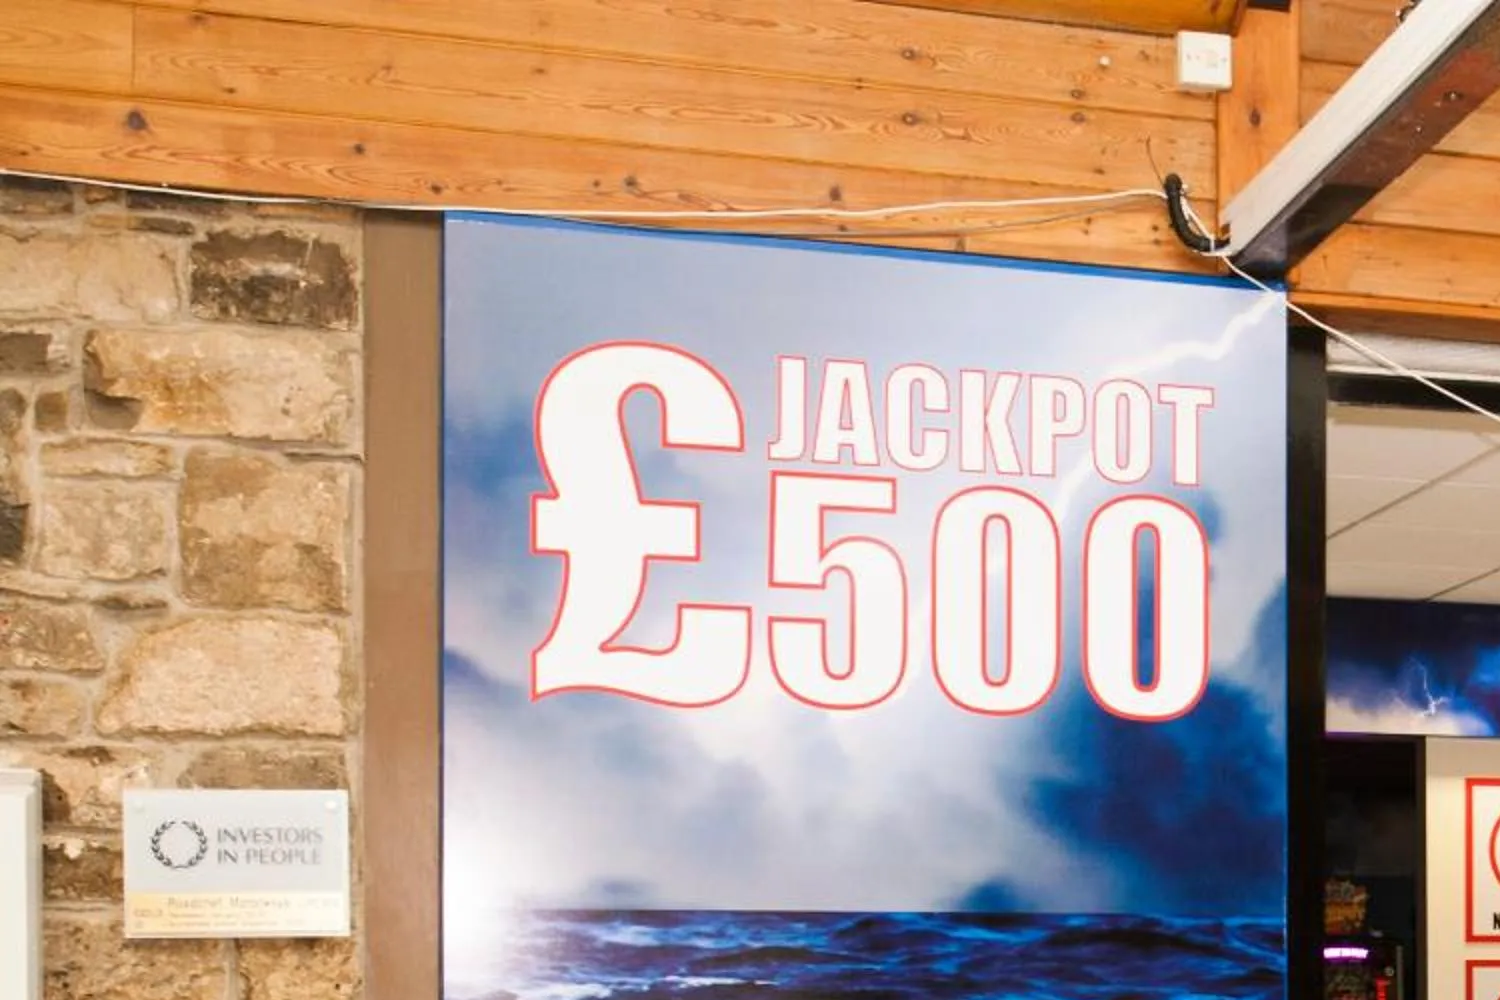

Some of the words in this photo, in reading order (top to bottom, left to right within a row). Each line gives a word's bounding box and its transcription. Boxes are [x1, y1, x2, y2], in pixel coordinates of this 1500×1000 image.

[767, 355, 1214, 486] JACKPOT
[217, 827, 323, 845] INVESTORS
[217, 848, 239, 865] IN
[246, 848, 321, 865] PEOPLE
